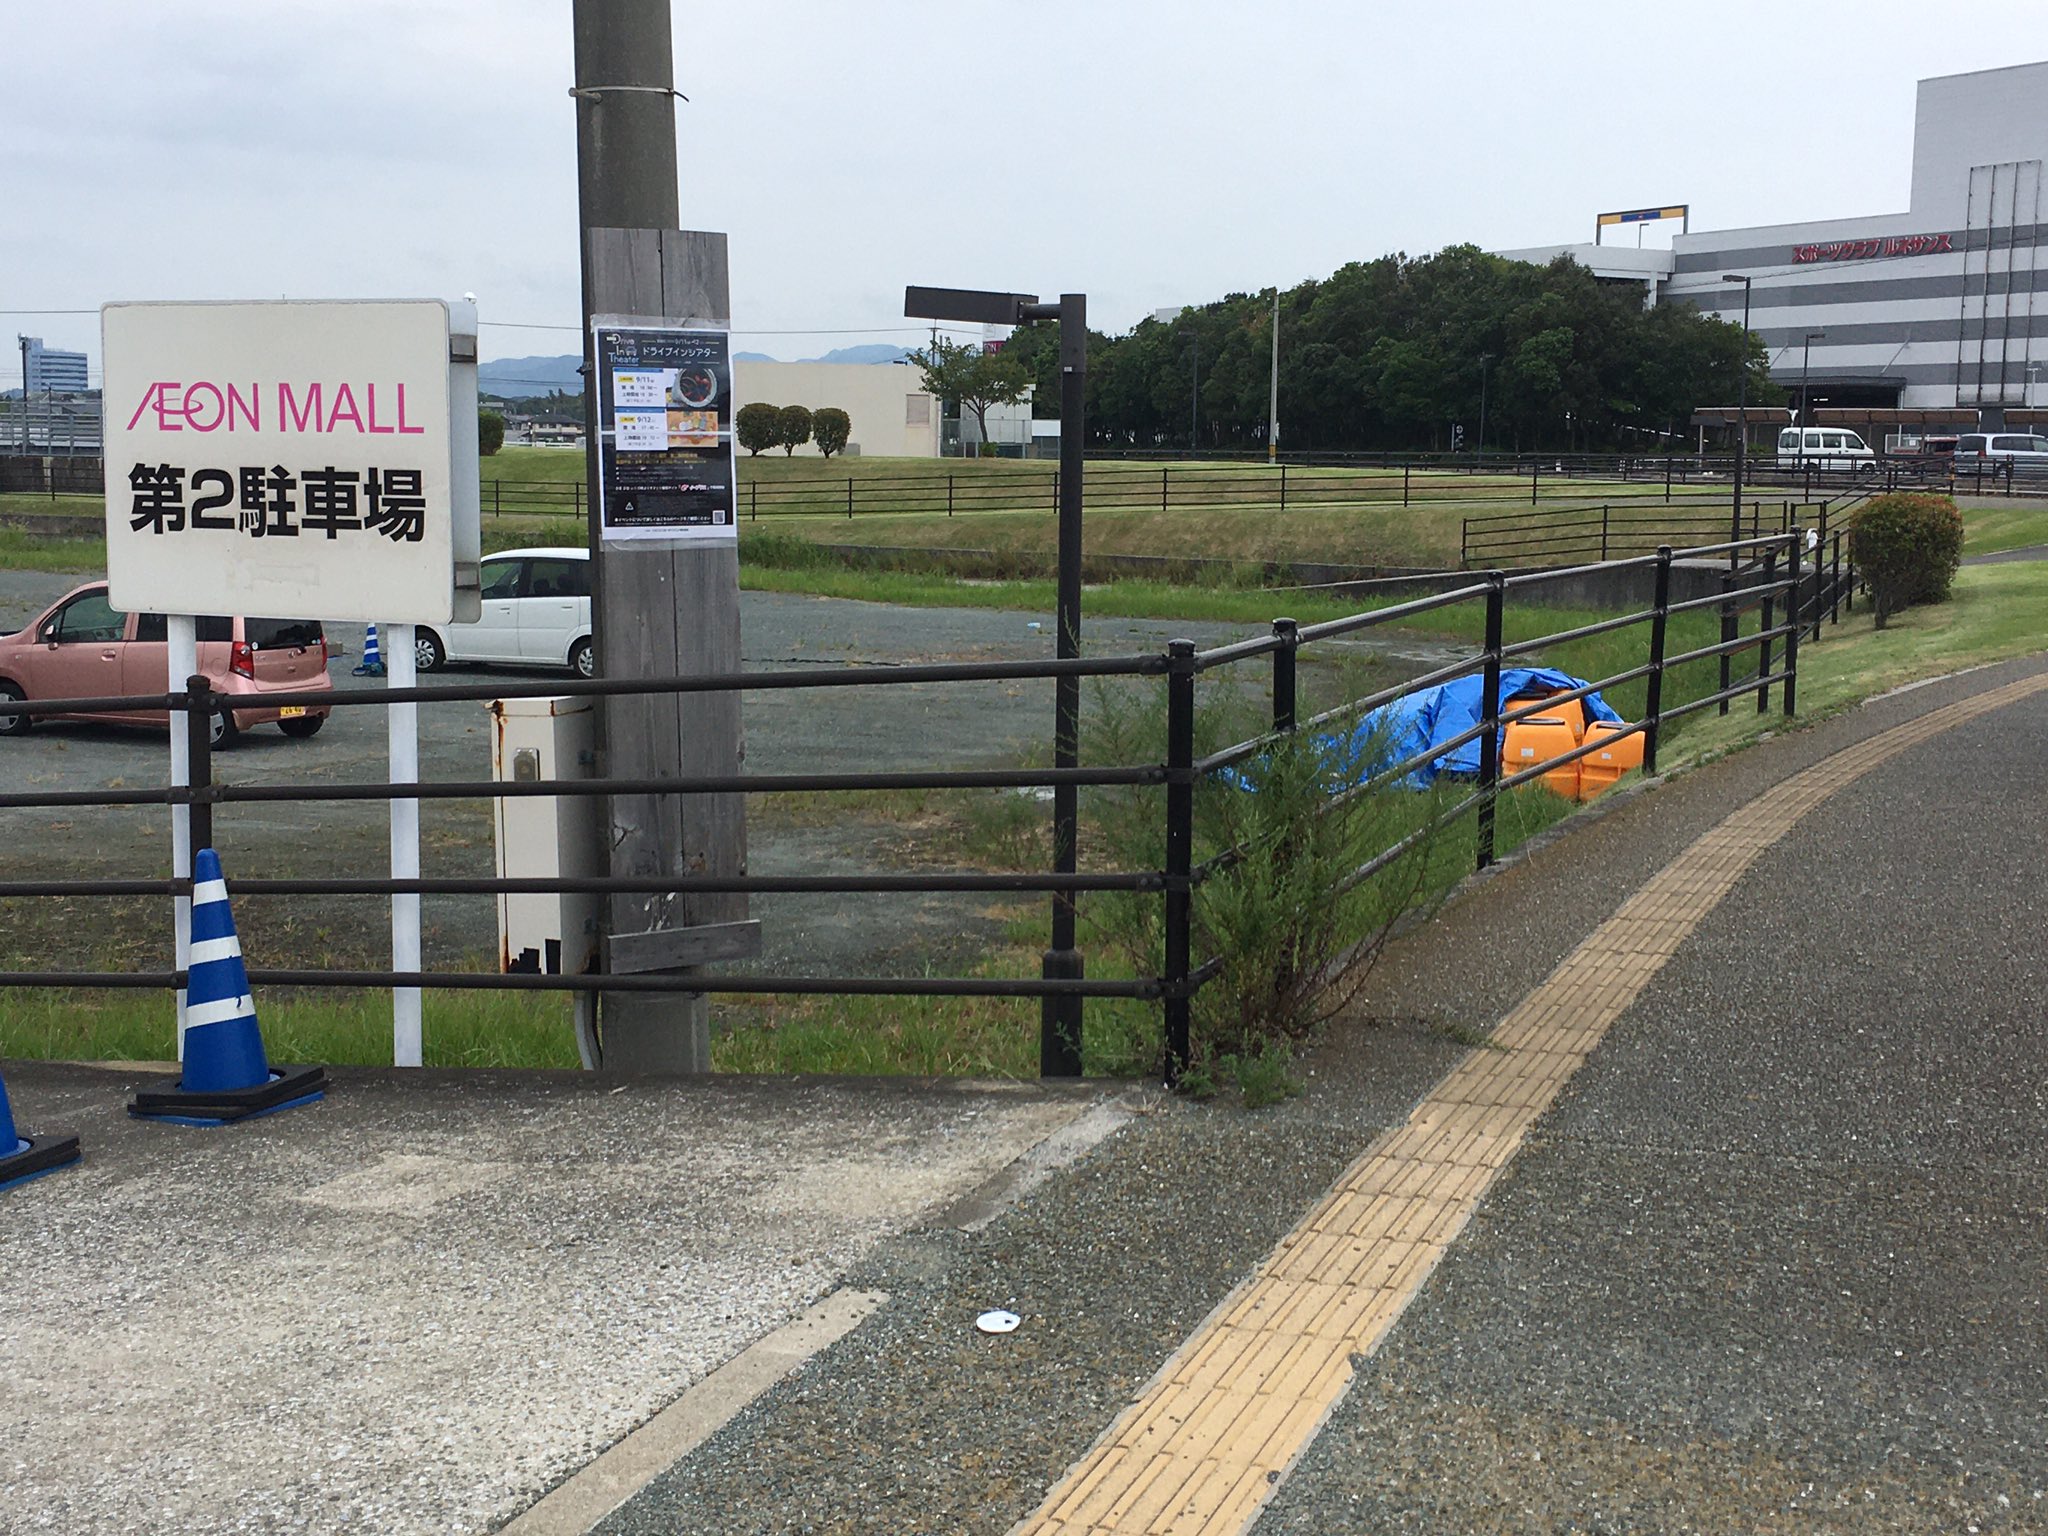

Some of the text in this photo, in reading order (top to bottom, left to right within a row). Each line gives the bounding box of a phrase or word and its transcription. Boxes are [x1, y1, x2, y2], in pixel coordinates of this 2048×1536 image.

[1791, 233, 1952, 264] スポーツクラブ ルネサンス
[608, 352, 639, 364] Theater
[643, 346, 718, 357] ドライブインシアター
[279, 382, 425, 434] MALL
[128, 462, 427, 542] 第2駐車場
